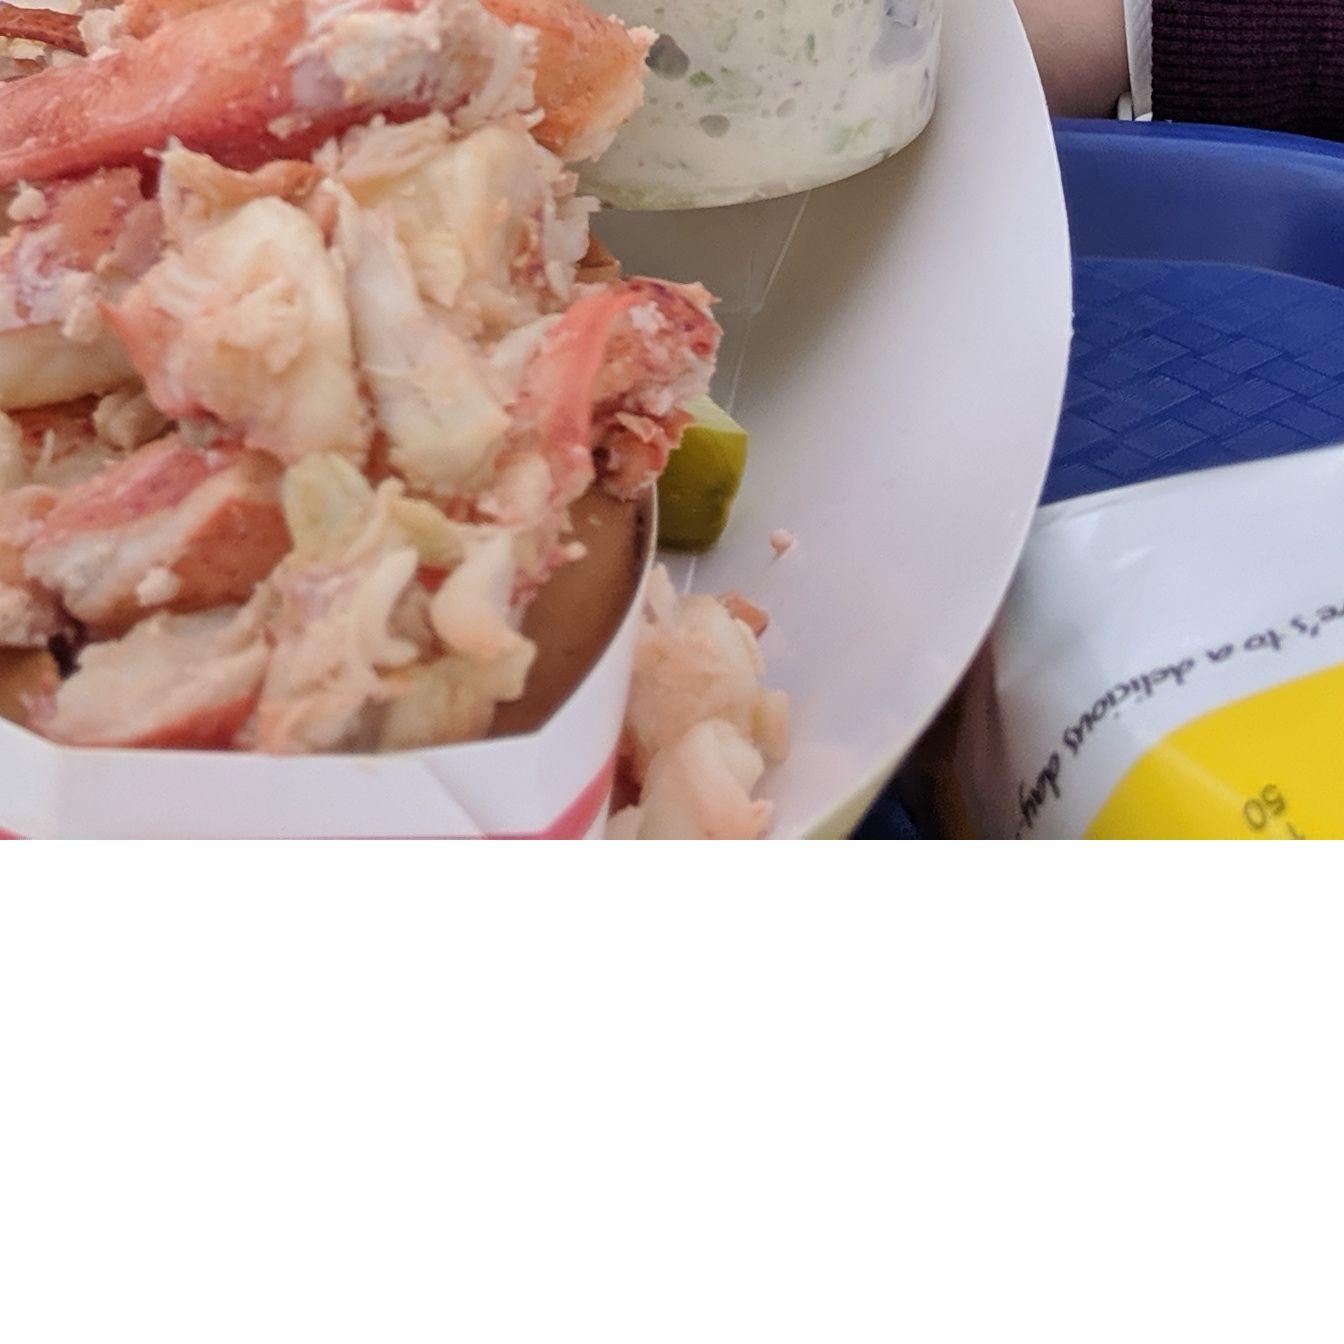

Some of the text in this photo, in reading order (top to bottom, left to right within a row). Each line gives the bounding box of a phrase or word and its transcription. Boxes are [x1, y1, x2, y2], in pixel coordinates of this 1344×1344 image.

[1205, 642, 1235, 663] a
[1243, 628, 1286, 652] to
[1062, 657, 1197, 756] delicious
[1243, 783, 1287, 831] 50
